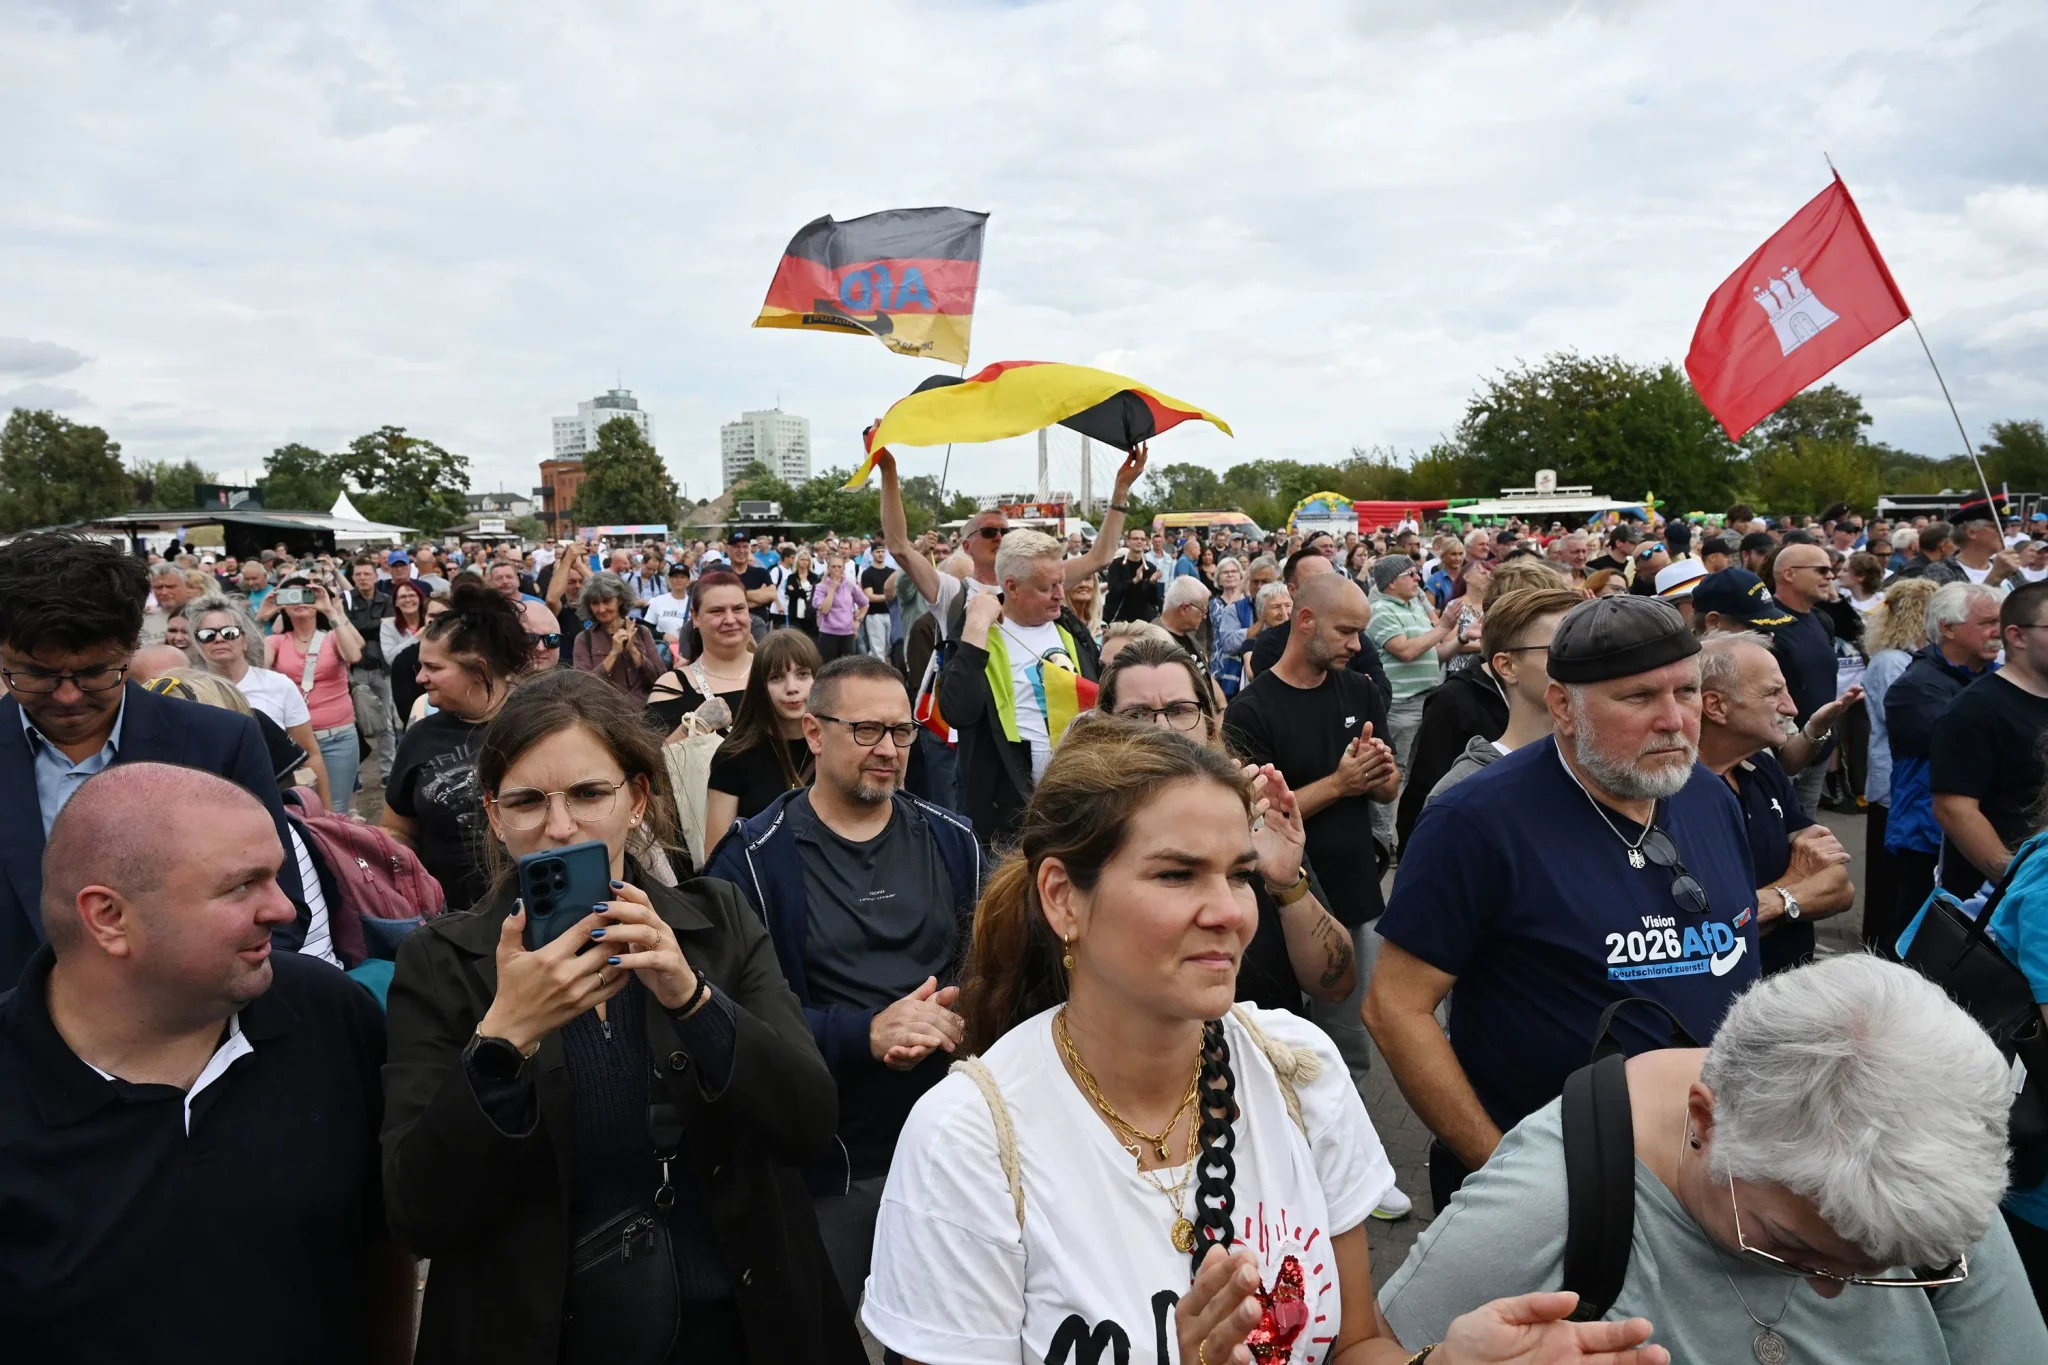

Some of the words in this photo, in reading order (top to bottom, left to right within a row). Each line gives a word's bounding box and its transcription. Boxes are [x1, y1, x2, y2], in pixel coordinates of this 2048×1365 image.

[1641, 915, 1676, 929] Vision
[1605, 928, 1682, 964] 2026
[1682, 921, 1735, 958] AfD
[1613, 965, 1673, 978] Deutschland
[1674, 963, 1704, 975] zuerst!
